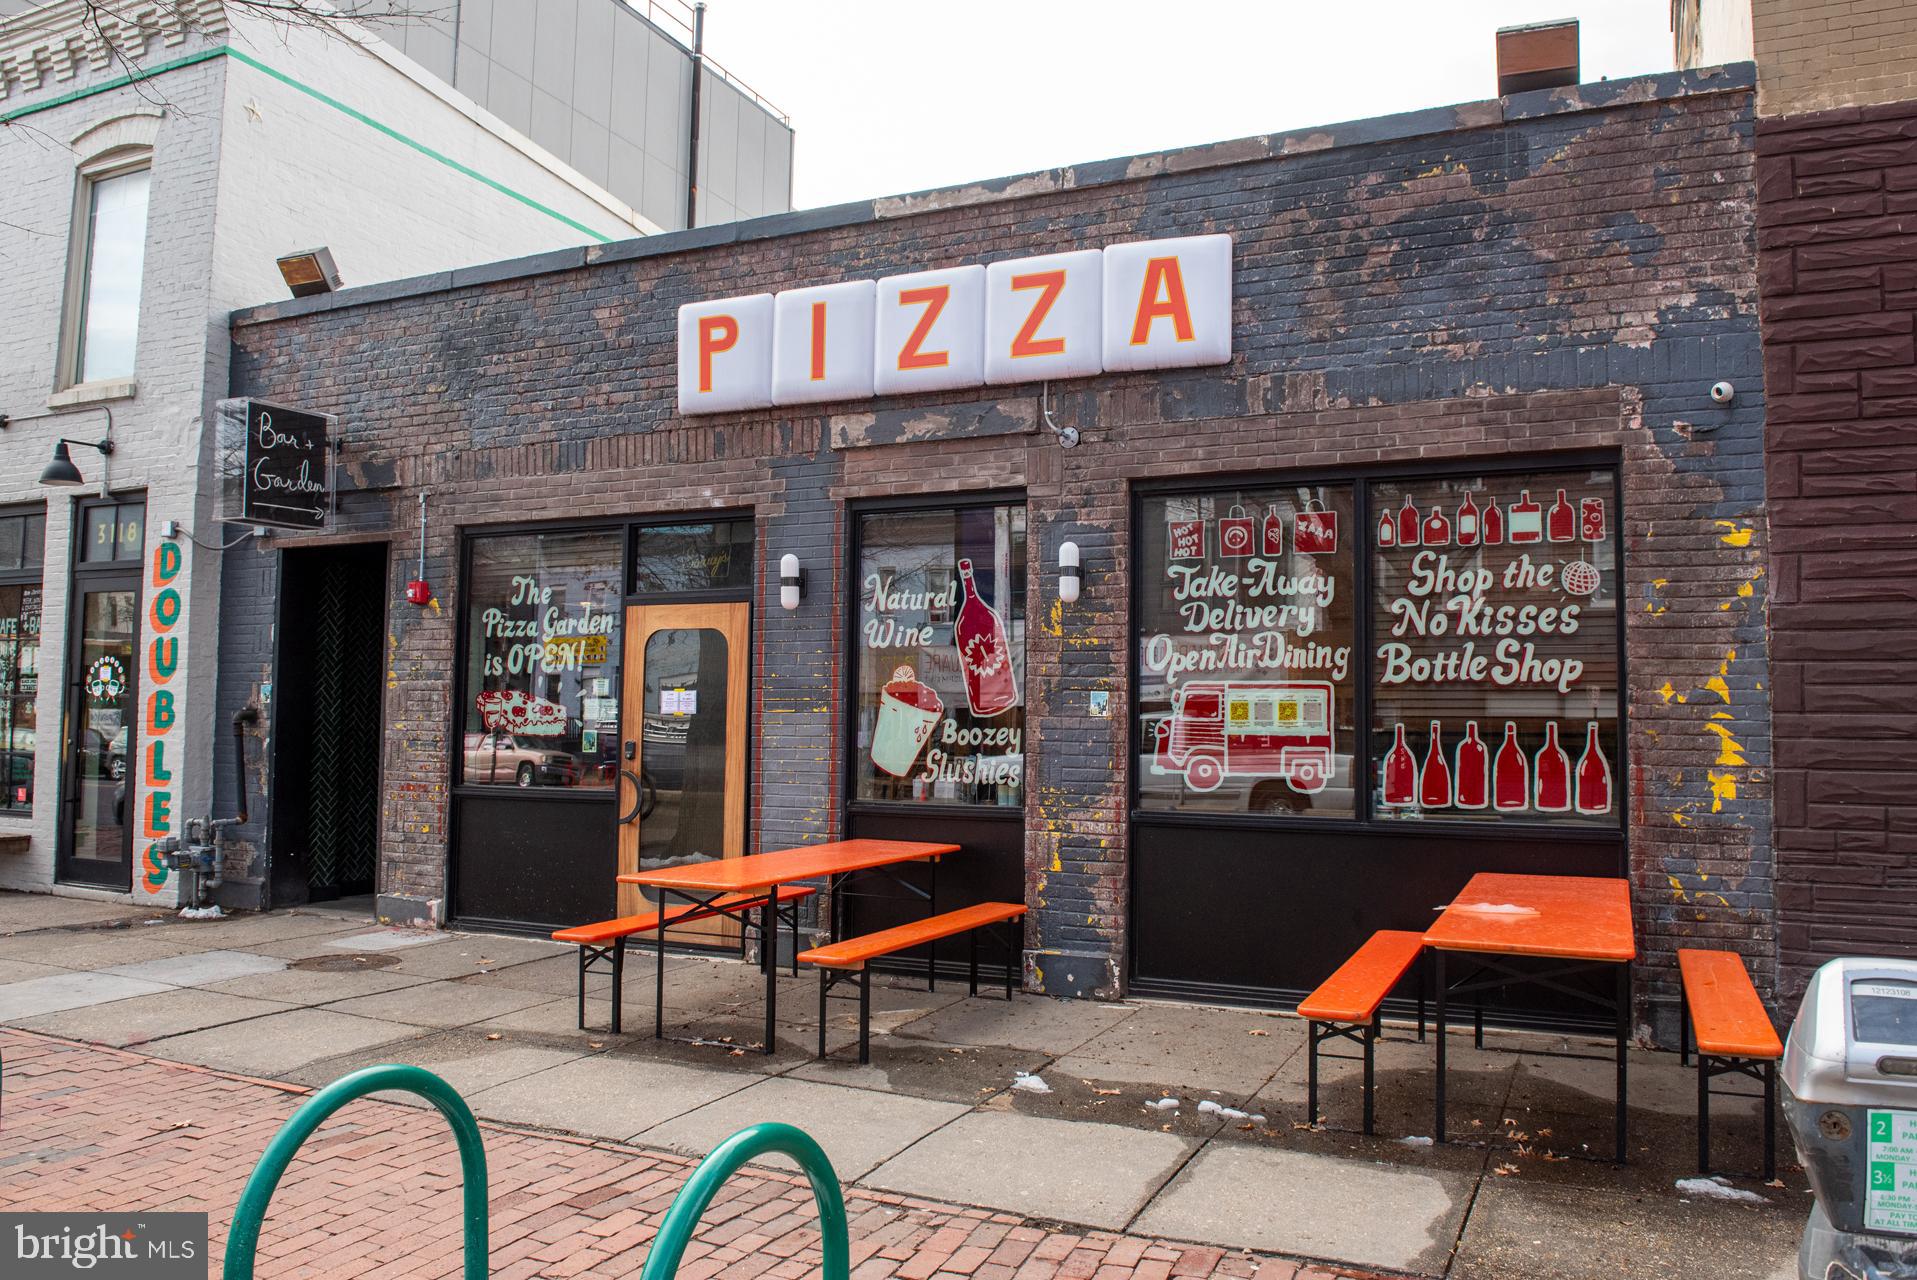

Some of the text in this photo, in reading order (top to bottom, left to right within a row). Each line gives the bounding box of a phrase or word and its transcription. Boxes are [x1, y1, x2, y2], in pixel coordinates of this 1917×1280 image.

[698, 255, 1196, 393] PIZZA
[259, 411, 300, 449] Bar
[254, 456, 325, 493] Garden
[97, 522, 137, 544] 3118
[1173, 522, 1194, 538] HOT
[1177, 534, 1199, 547] HOT
[1174, 546, 1198, 558] HOT
[511, 575, 552, 606] The
[864, 573, 957, 612] Natural
[1167, 558, 1335, 607] Take-Away
[1407, 550, 1554, 602] Shop the
[482, 603, 614, 642] Pizza Garden
[864, 618, 935, 649] Wine
[1180, 599, 1315, 637] Delivery
[1391, 595, 1581, 636] No Kisses
[484, 653, 503, 677] is
[507, 640, 586, 674] OPEN!
[1147, 631, 1351, 684] Open Air Dining
[1377, 637, 1584, 694] Bottle Shop
[143, 541, 182, 895] DOUBLES
[941, 718, 1021, 755] Boozey
[921, 749, 1021, 788] Slushies
[1876, 1121, 1886, 1136] 2
[1876, 1153, 1910, 1162] MONDAY
[1875, 1218, 1885, 1226] AT
[1886, 1219, 1900, 1227] ALL
[1889, 1211, 1906, 1219] PAY
